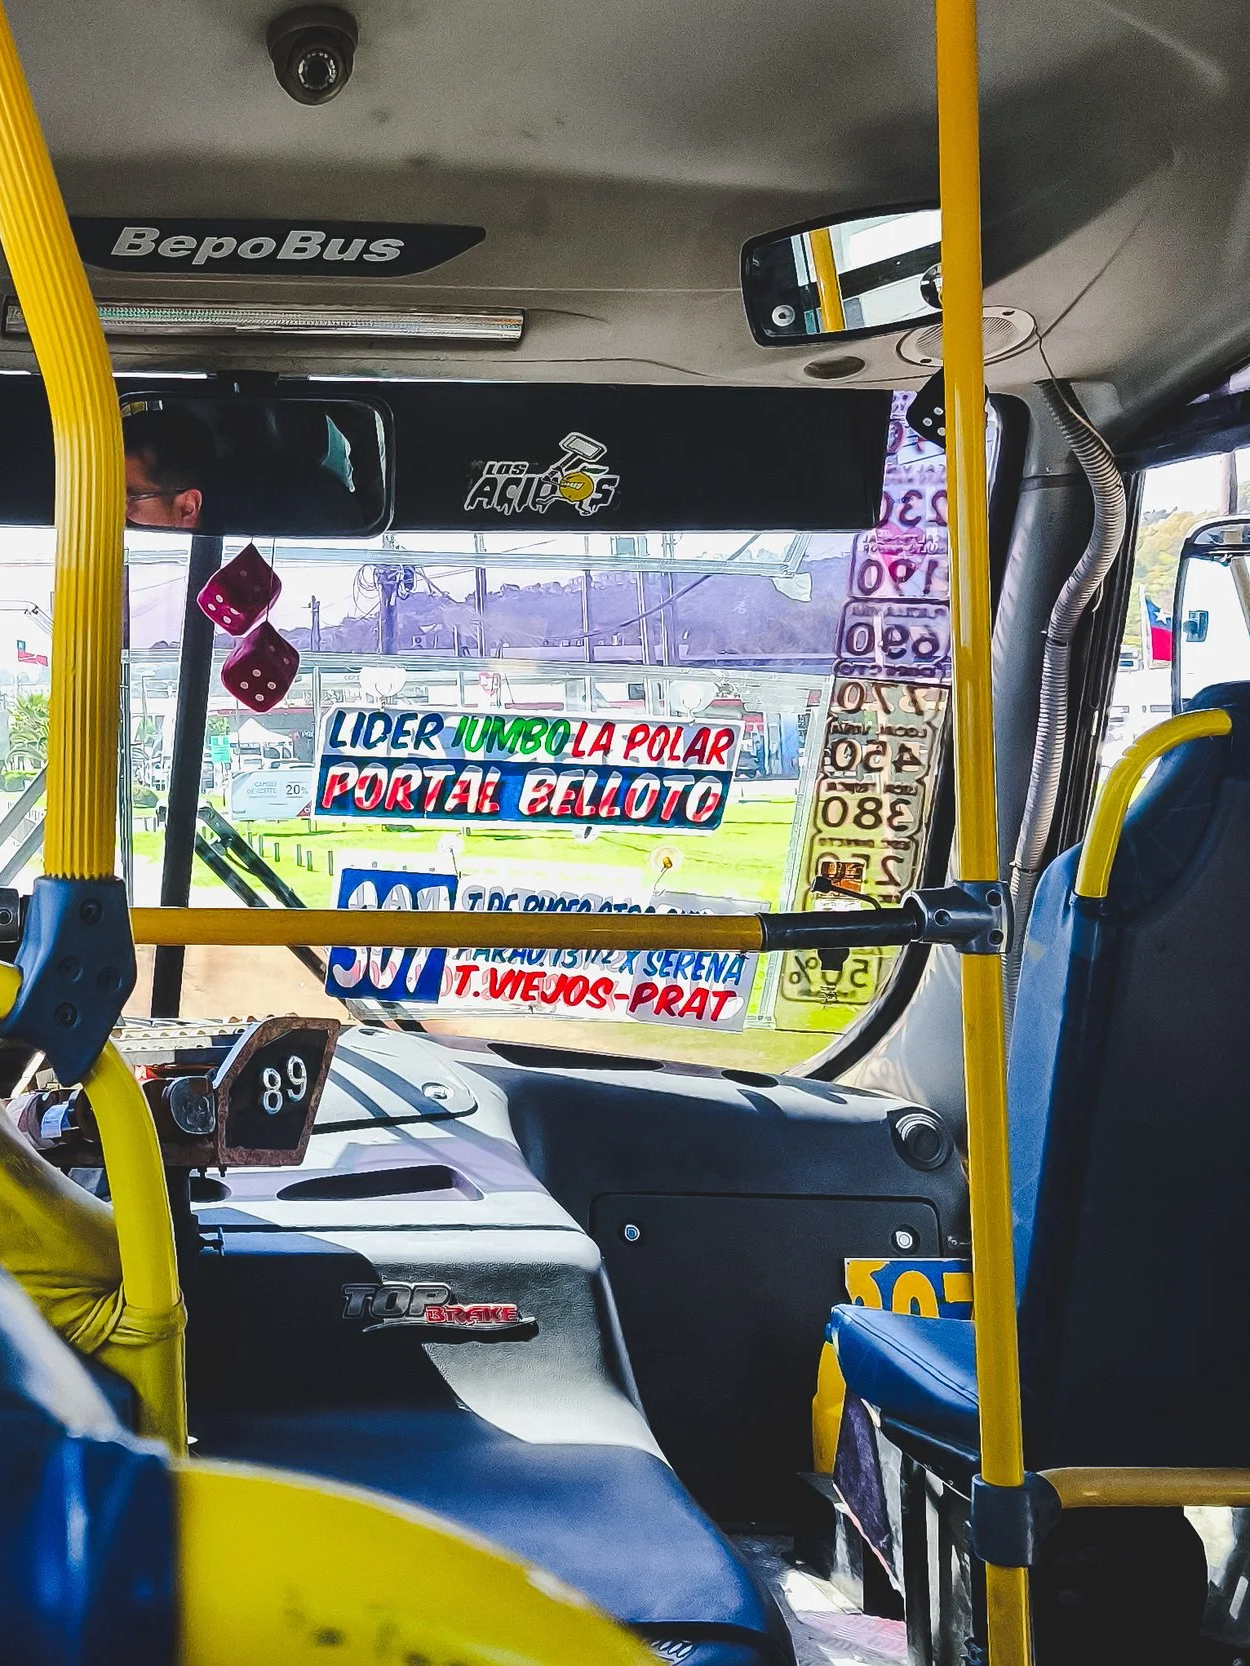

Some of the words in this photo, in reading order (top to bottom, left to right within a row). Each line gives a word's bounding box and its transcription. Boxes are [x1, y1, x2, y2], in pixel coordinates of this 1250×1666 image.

[110, 226, 405, 265] BepoBus
[482, 460, 530, 477] LOS
[328, 710, 444, 750] LIDER
[572, 720, 616, 759] LA
[623, 723, 736, 766] POLAR
[320, 763, 501, 815] PORTAL
[517, 768, 723, 823] BELLOTO
[456, 965, 481, 998] T.
[261, 1055, 308, 1115] 89
[341, 1281, 452, 1319] TOP
[425, 1303, 519, 1325] BRAKE
